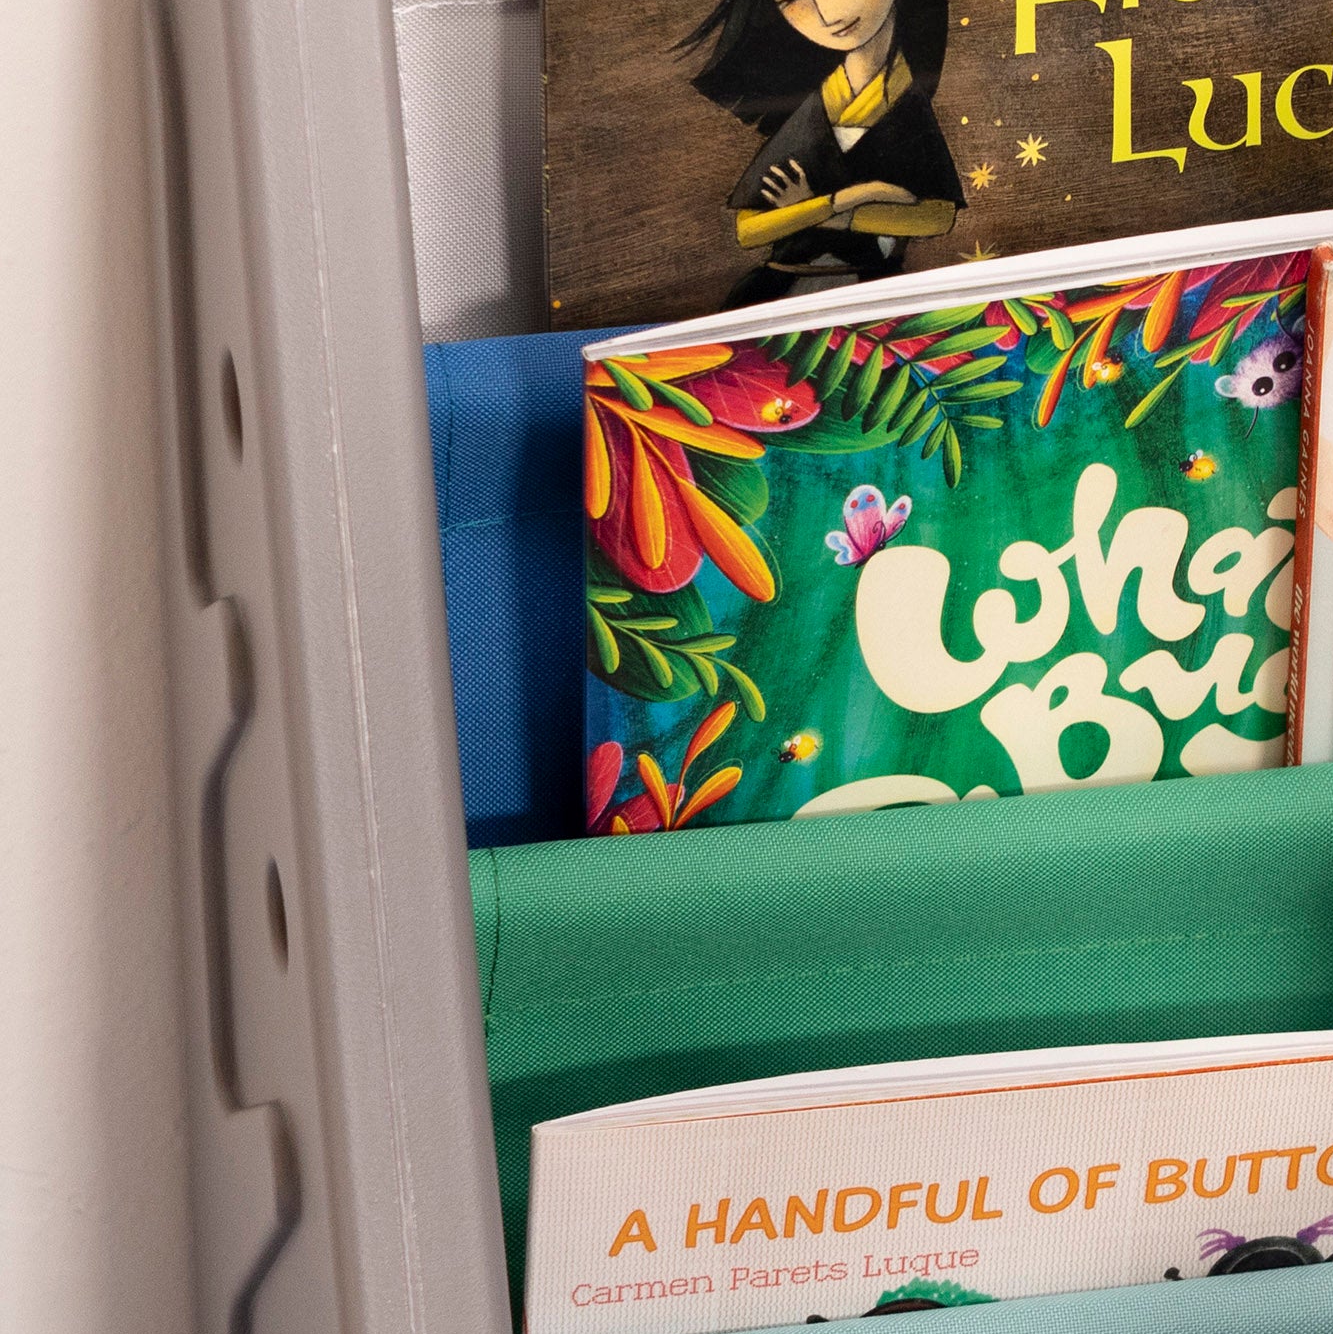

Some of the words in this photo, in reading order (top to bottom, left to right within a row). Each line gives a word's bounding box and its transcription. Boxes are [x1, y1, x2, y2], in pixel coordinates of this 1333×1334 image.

[1302, 323, 1315, 420] JOANNA
[1299, 430, 1311, 520] GAINES
[607, 1208, 659, 1258] A
[683, 1175, 1004, 1249] HANDFUL
[1028, 1163, 1121, 1215] OF
[570, 1272, 715, 1308] Carmen
[729, 1258, 848, 1292] Parets
[861, 1247, 981, 1280] Luque
